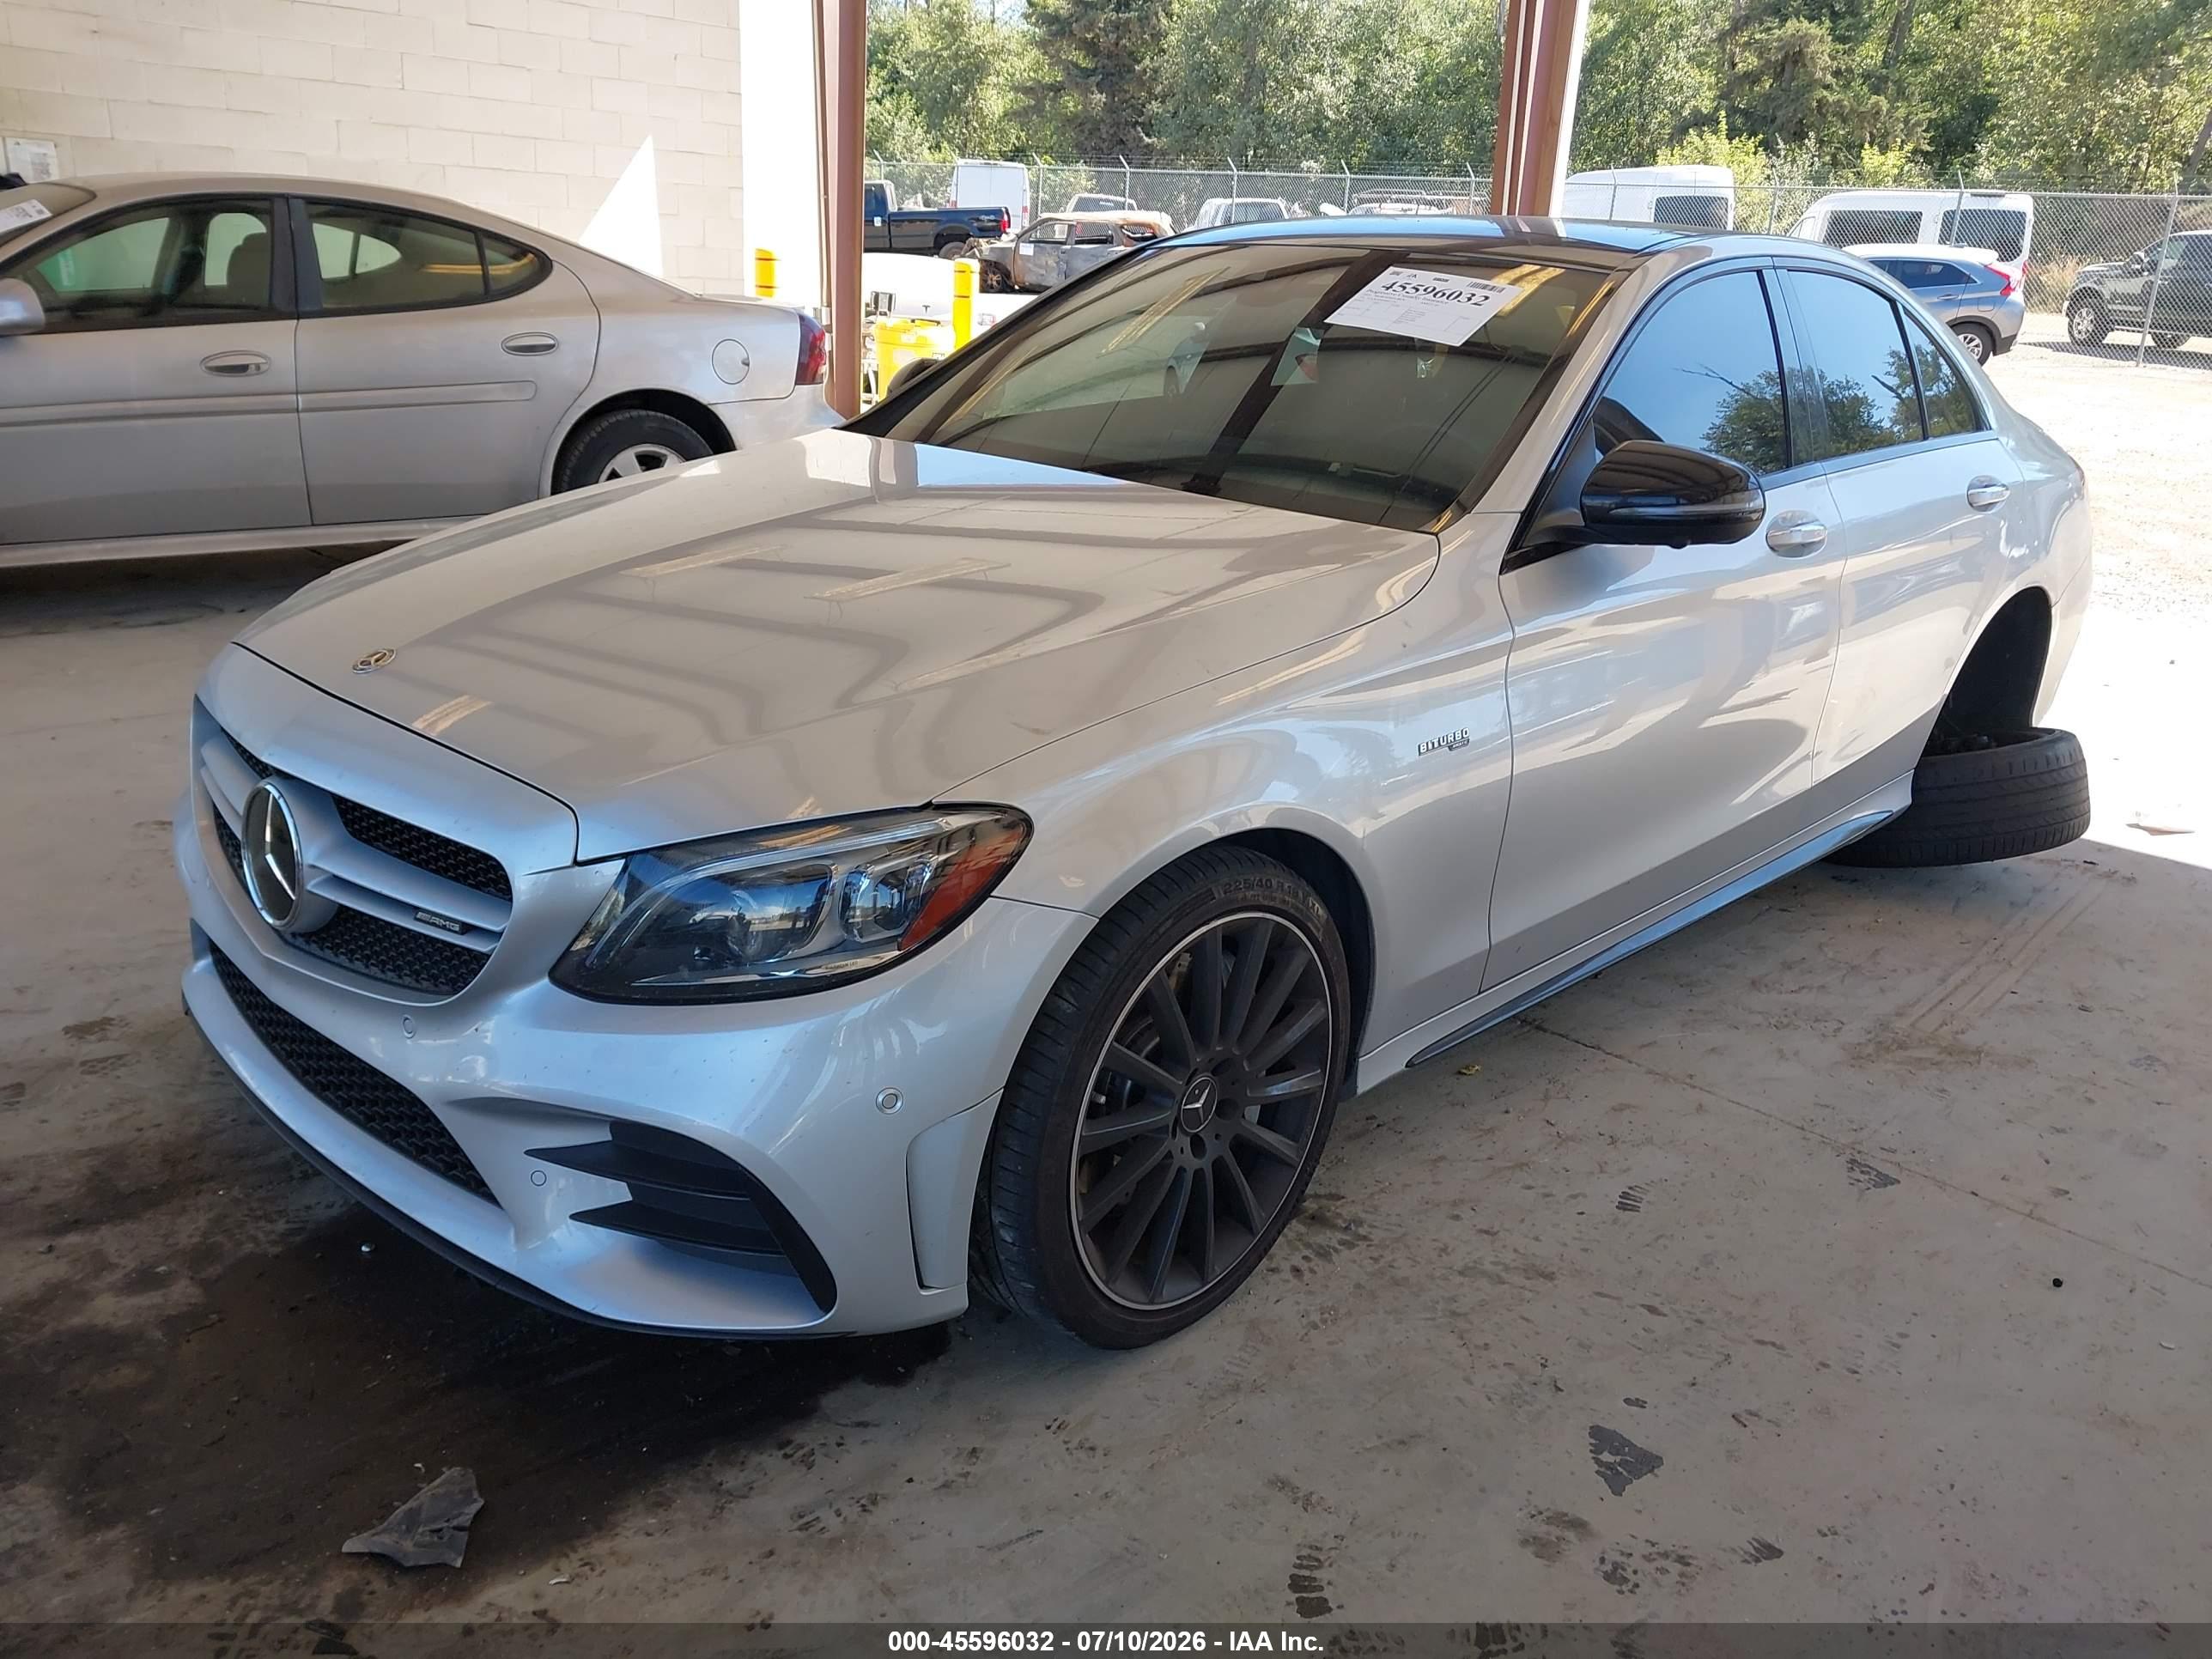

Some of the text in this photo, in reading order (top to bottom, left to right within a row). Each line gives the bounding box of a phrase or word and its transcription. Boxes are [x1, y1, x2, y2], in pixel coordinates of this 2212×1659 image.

[1381, 281, 1491, 307] 45596032
[1419, 727, 1469, 755] BITURBO
[1223, 878, 1273, 894] 225/40
[429, 916, 460, 932] AMG
